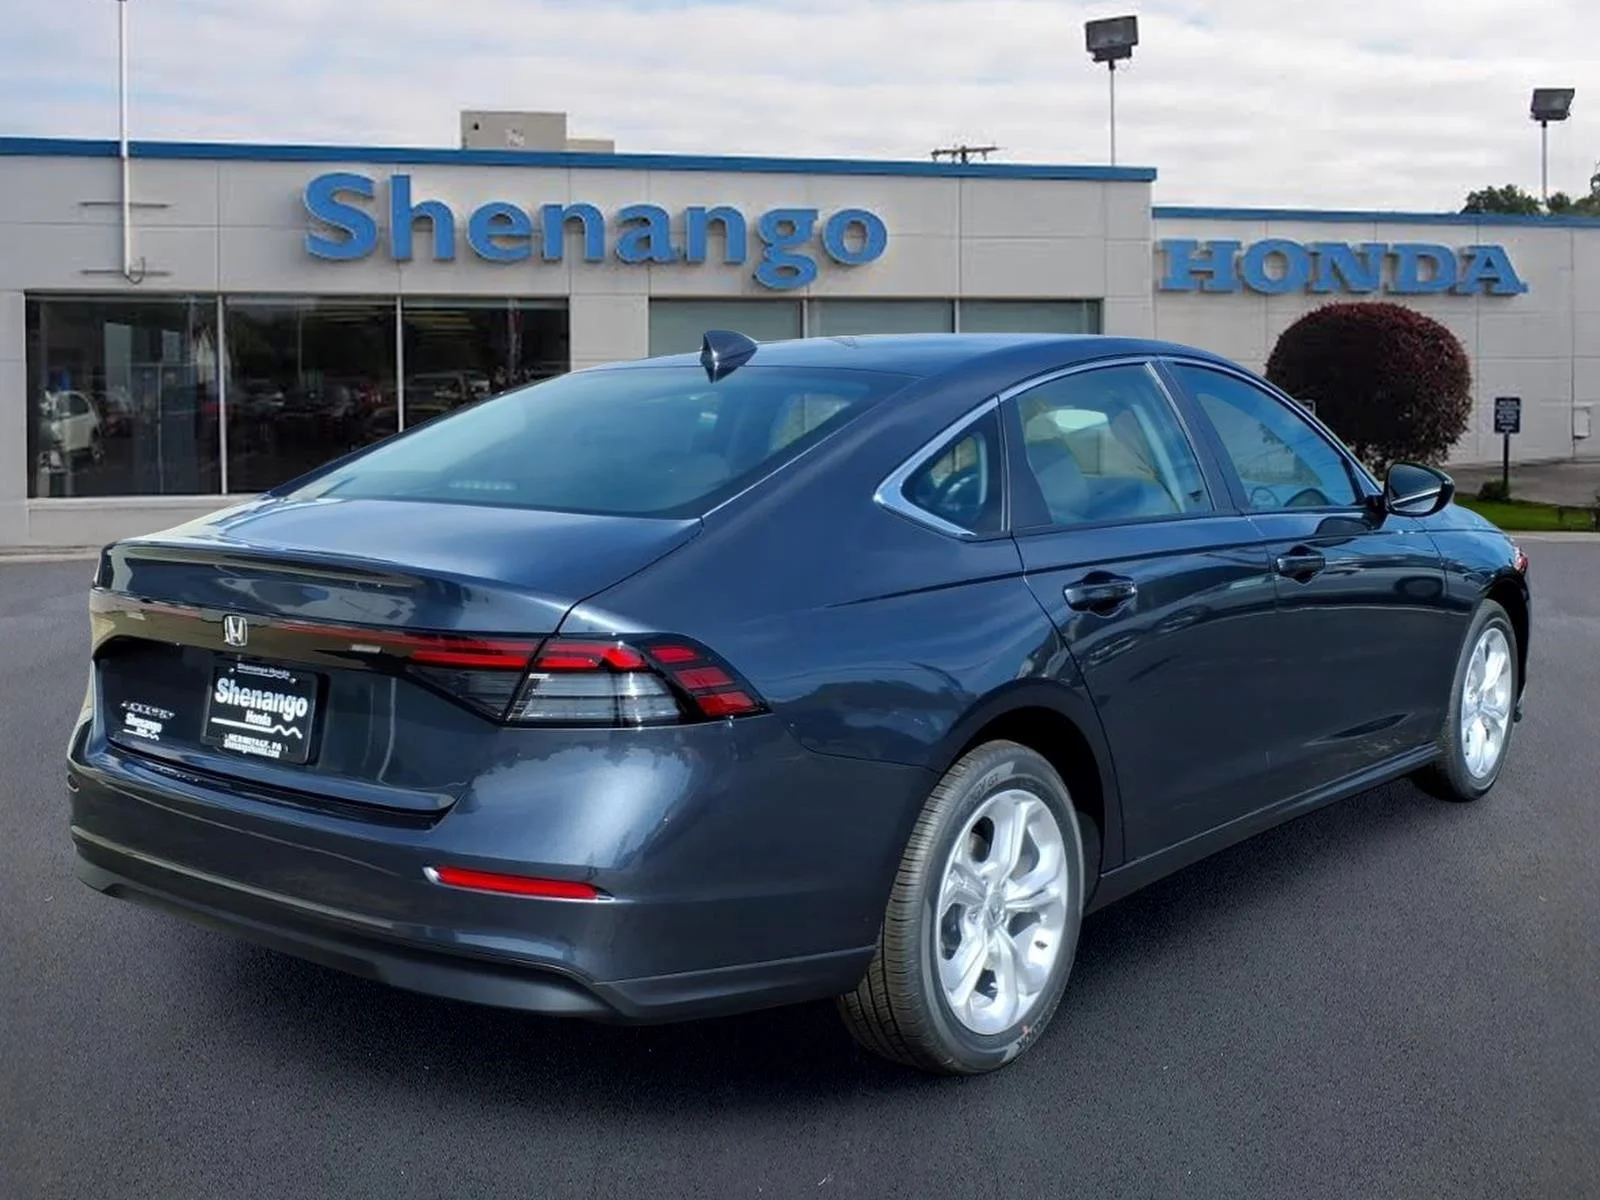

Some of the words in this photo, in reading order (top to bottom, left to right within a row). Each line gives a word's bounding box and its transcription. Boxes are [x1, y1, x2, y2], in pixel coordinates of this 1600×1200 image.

[303, 172, 888, 290] Shenango
[1159, 238, 1528, 294] HONDA
[214, 677, 308, 722] Shenango
[245, 709, 272, 727] Honda
